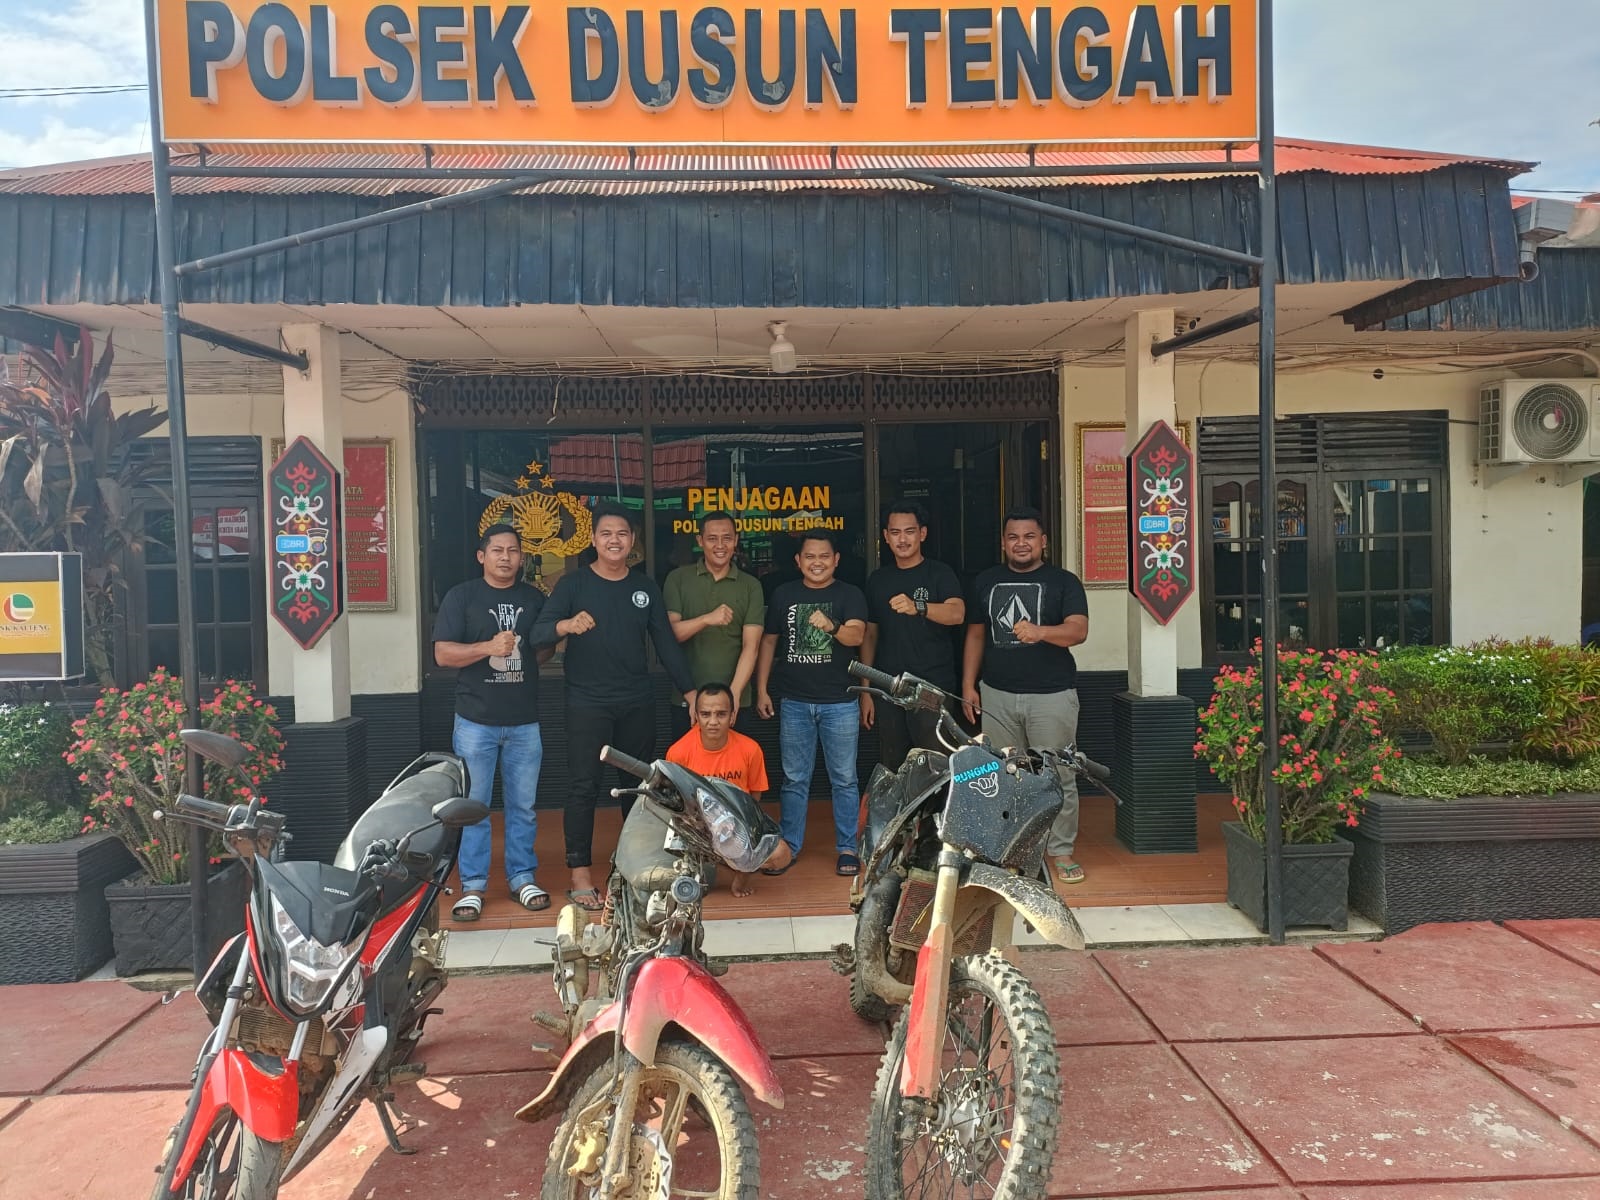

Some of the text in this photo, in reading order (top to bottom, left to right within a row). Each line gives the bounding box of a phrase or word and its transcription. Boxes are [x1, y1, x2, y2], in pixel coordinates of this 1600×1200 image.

[186, 0, 1233, 112] POLSEK DUSUN TENGAH
[687, 485, 830, 512] PENJAGAAN
[673, 519, 700, 534] POL
[787, 654, 822, 663] STONE
[953, 761, 1000, 783] RUNGKAD
[324, 886, 350, 897] HONDA
